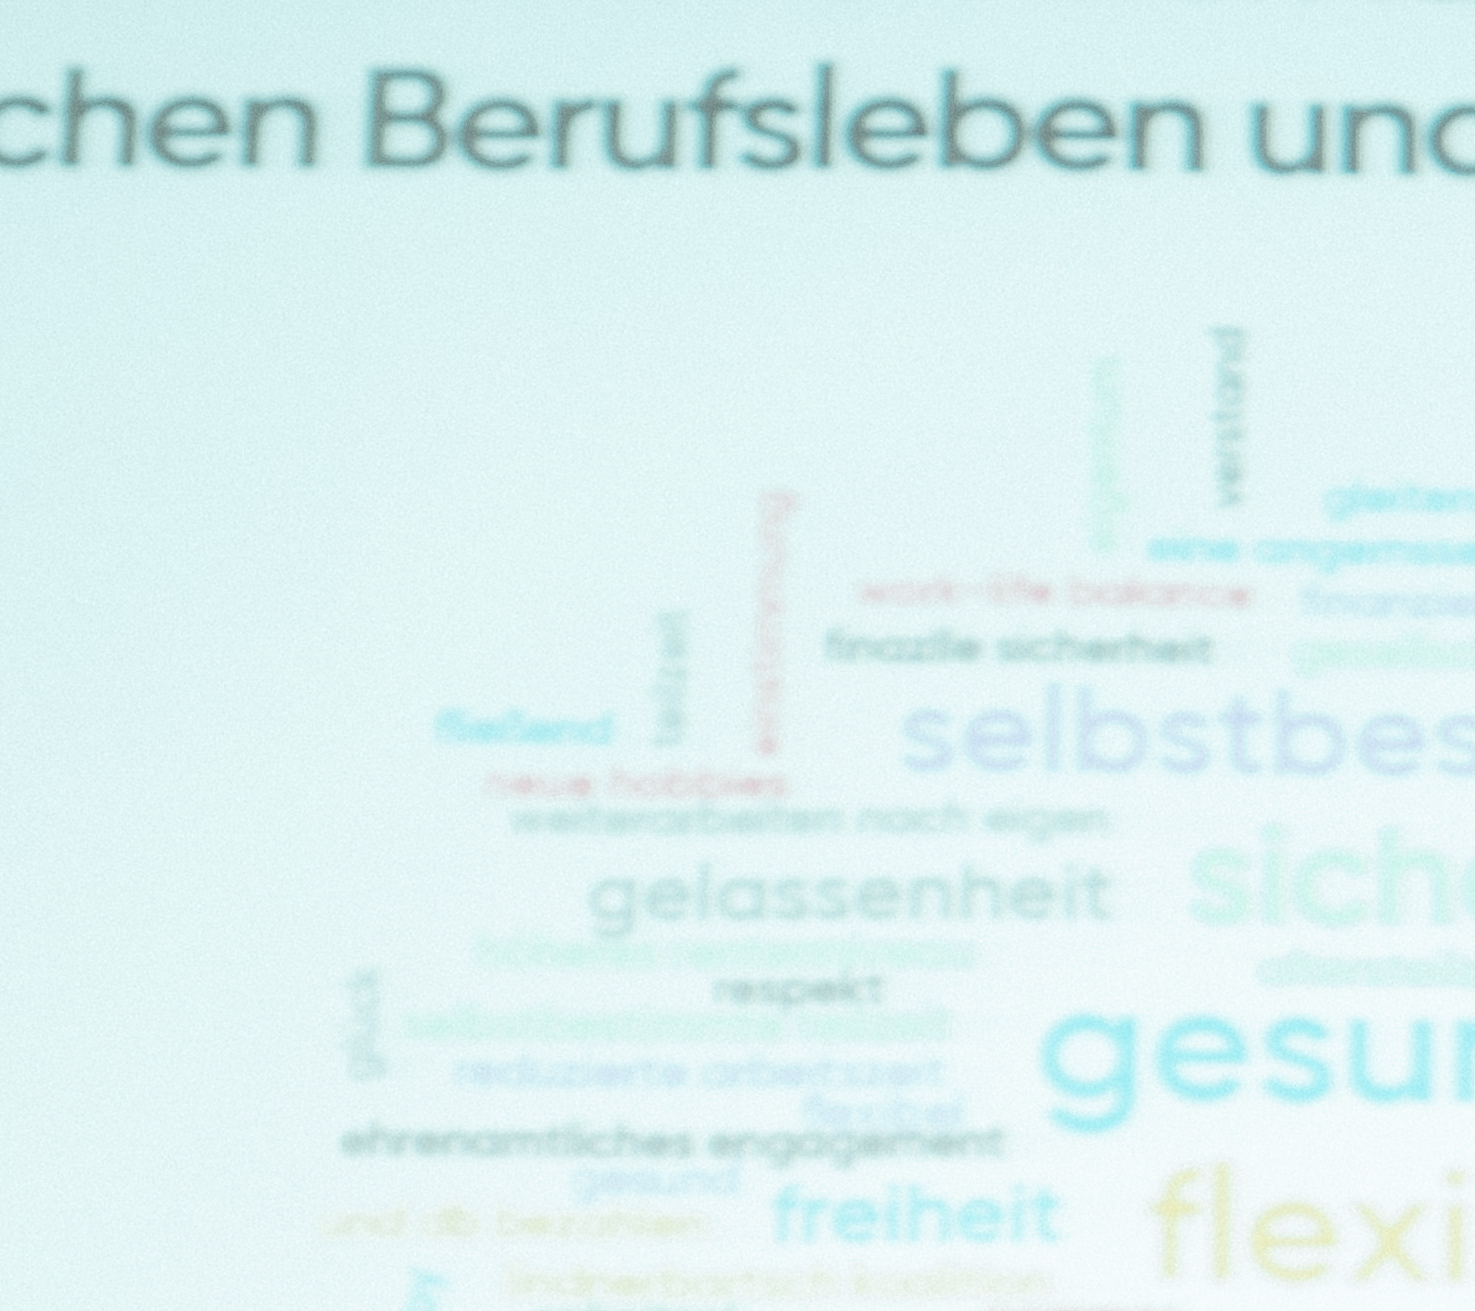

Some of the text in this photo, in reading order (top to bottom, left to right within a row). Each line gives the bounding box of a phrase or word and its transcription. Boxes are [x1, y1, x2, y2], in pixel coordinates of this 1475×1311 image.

[363, 62, 1206, 172] Berufsleben
[1146, 536, 1241, 564] eine
[995, 630, 1213, 665] sicherheit
[484, 767, 786, 799] neue hobbies
[511, 804, 1110, 844] weiterarbeiten nach eigen
[586, 860, 1112, 940] gelassenheit
[712, 966, 886, 1008] respekt
[338, 1120, 1007, 1170] ehrenamtliches engagement
[773, 1181, 1063, 1246] freiheit
